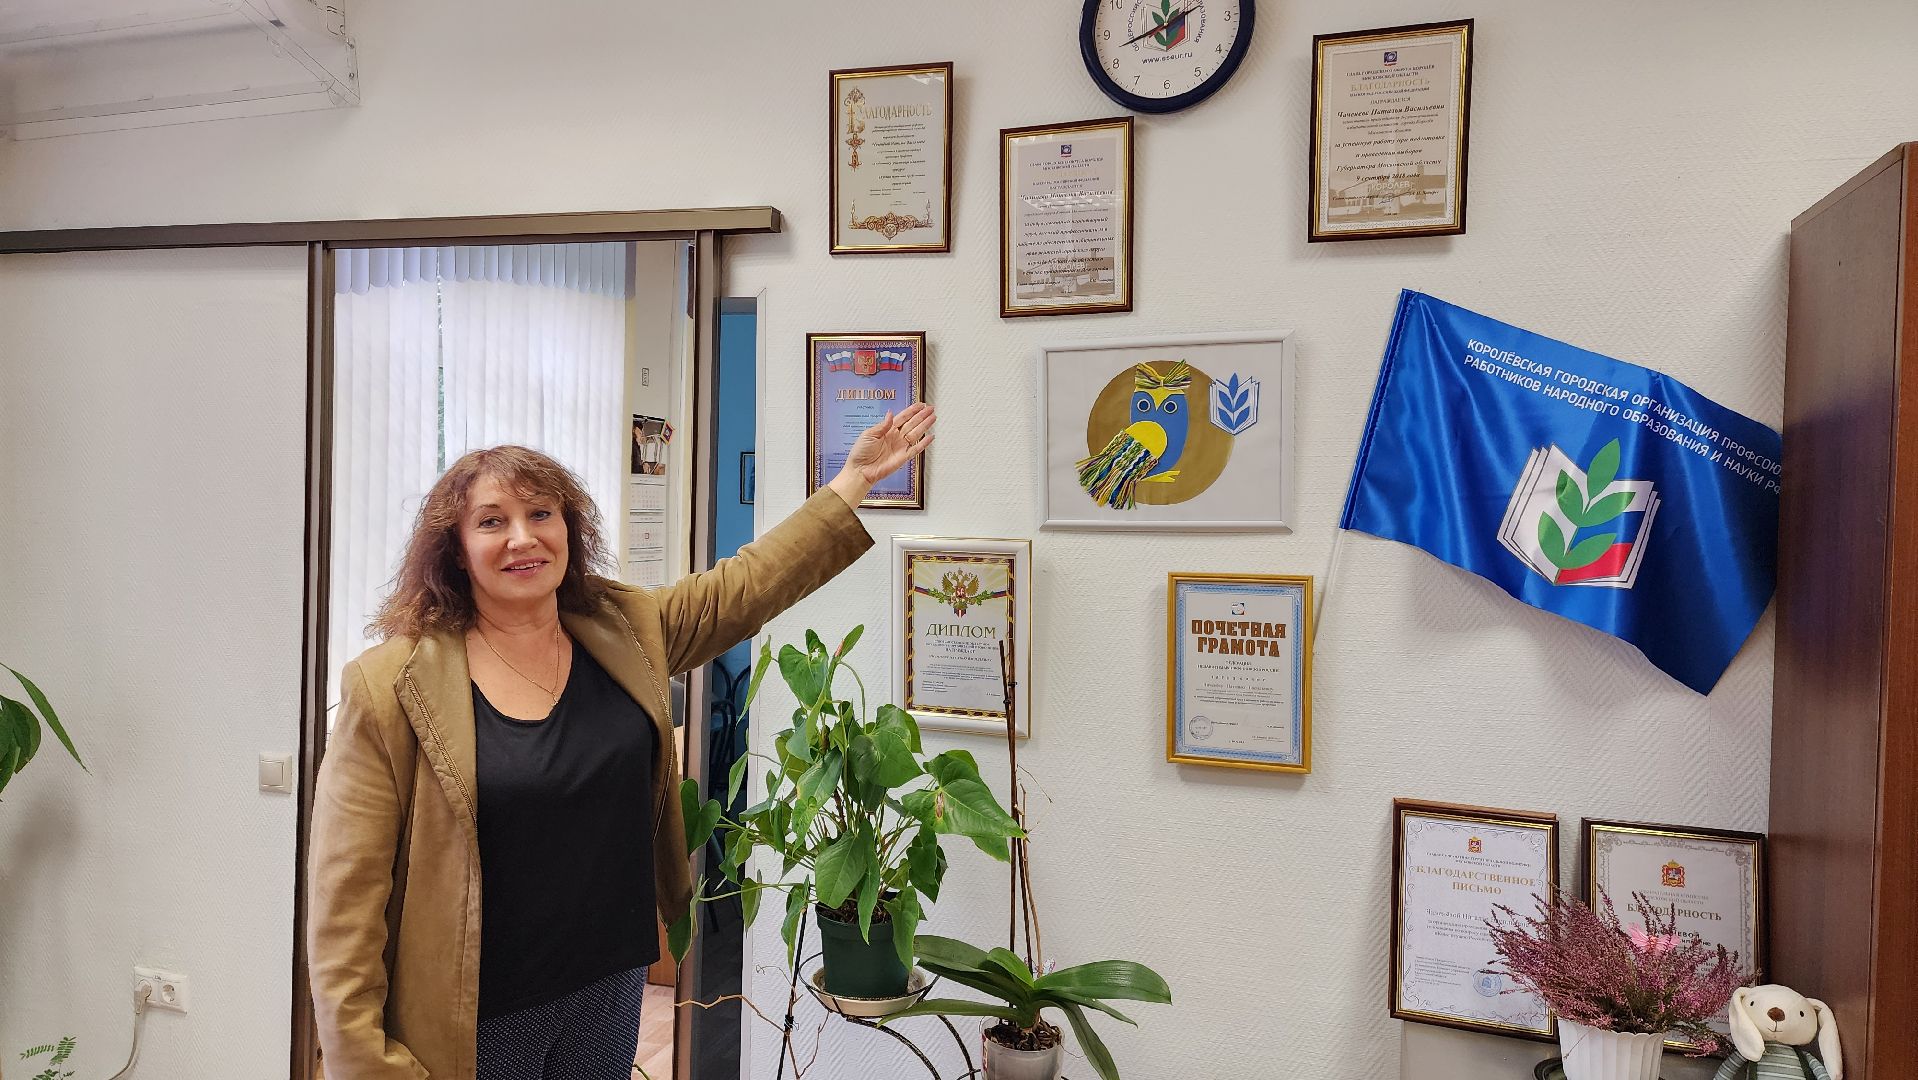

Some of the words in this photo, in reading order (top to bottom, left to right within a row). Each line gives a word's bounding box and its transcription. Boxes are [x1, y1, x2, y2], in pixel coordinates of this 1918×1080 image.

[1110, 0, 1122, 10] 10
[1224, 10, 1231, 21] 3
[1103, 29, 1111, 40] 9
[1215, 43, 1222, 54] 4
[1112, 58, 1119, 69] 8
[1141, 52, 1193, 64] www.eseur.ru
[1194, 66, 1201, 77] 5
[1133, 74, 1140, 86] 7
[1163, 79, 1170, 89] 6
[835, 388, 897, 402] ДИПЛОМ
[1467, 338, 1553, 378] КОРОЛЁВСКАЯ
[1554, 369, 1630, 402] ГОРОДСКАЯ
[1631, 394, 1720, 443] ОРГАНИЗАЦИЯ
[1721, 436, 1782, 476] ПРОФСОЮ
[1464, 354, 1542, 392] РАБОТНИКОВ
[1543, 384, 1620, 416] НАРОДНОГО
[1622, 408, 1710, 457] ОБРАЗОВАНИЯ
[1709, 449, 1723, 463] И
[1723, 456, 1765, 486] НАУКИ
[925, 623, 996, 640] ДИПЛОМ
[1191, 619, 1287, 639] ПОЧЕТНАЯ
[1197, 636, 1281, 658] ГРАМОТА
[1416, 865, 1536, 887] БЛАГОДАРСТВЕННОЕ
[1451, 881, 1502, 895] ПИСЬМО
